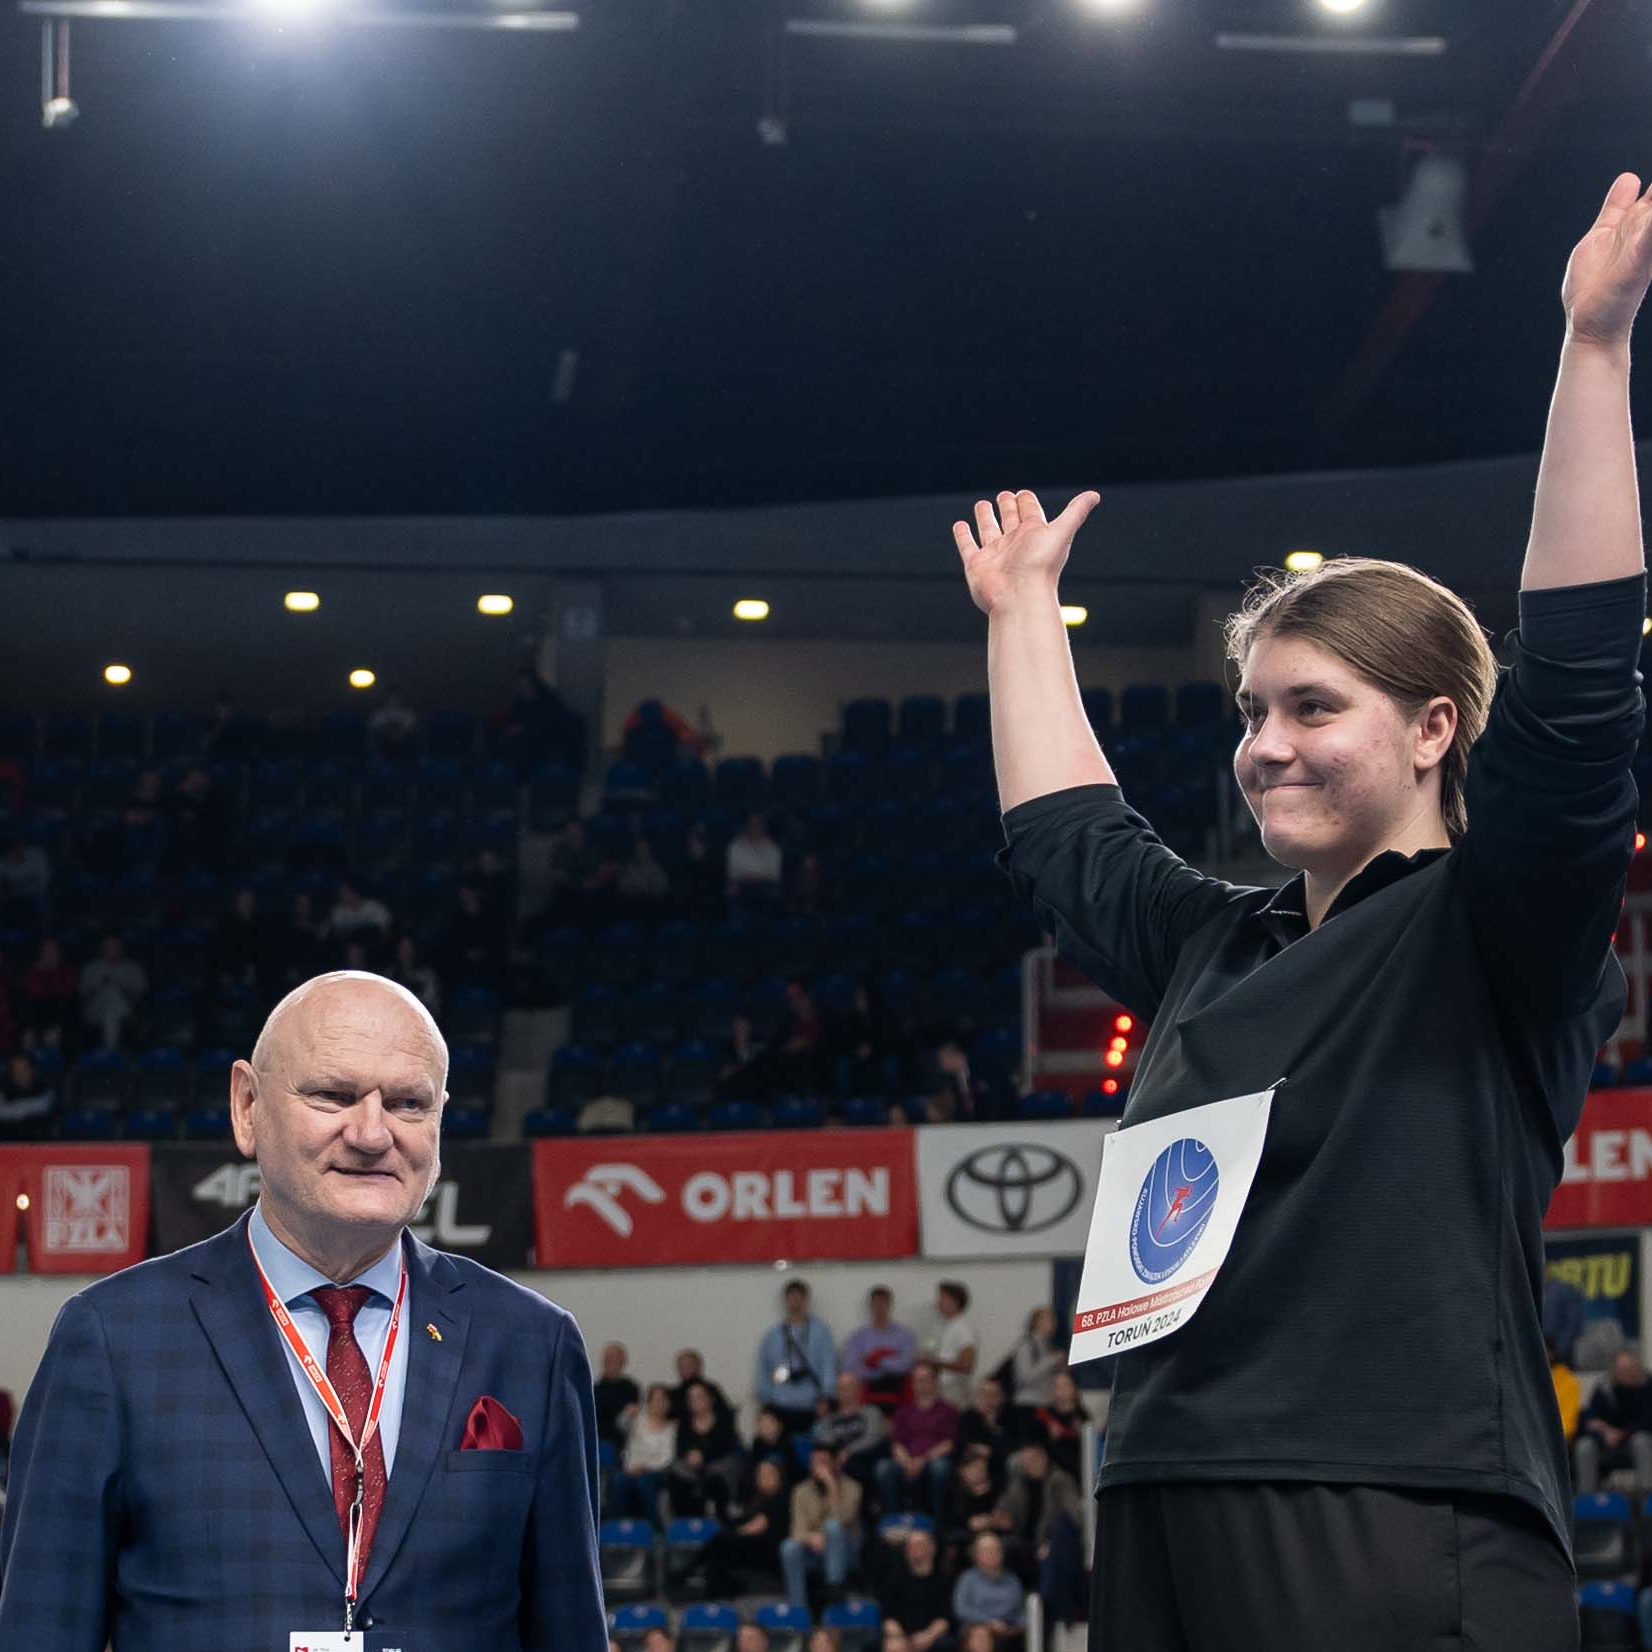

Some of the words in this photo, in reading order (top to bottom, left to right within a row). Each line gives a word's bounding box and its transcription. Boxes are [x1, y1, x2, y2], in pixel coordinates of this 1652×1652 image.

[683, 1165, 891, 1221] ORLEN
[1081, 1314, 1095, 1328] 68.
[1096, 1311, 1116, 1325] PZLA
[1108, 1317, 1152, 1348] TORUŃ
[1152, 1308, 1182, 1334] 2024
